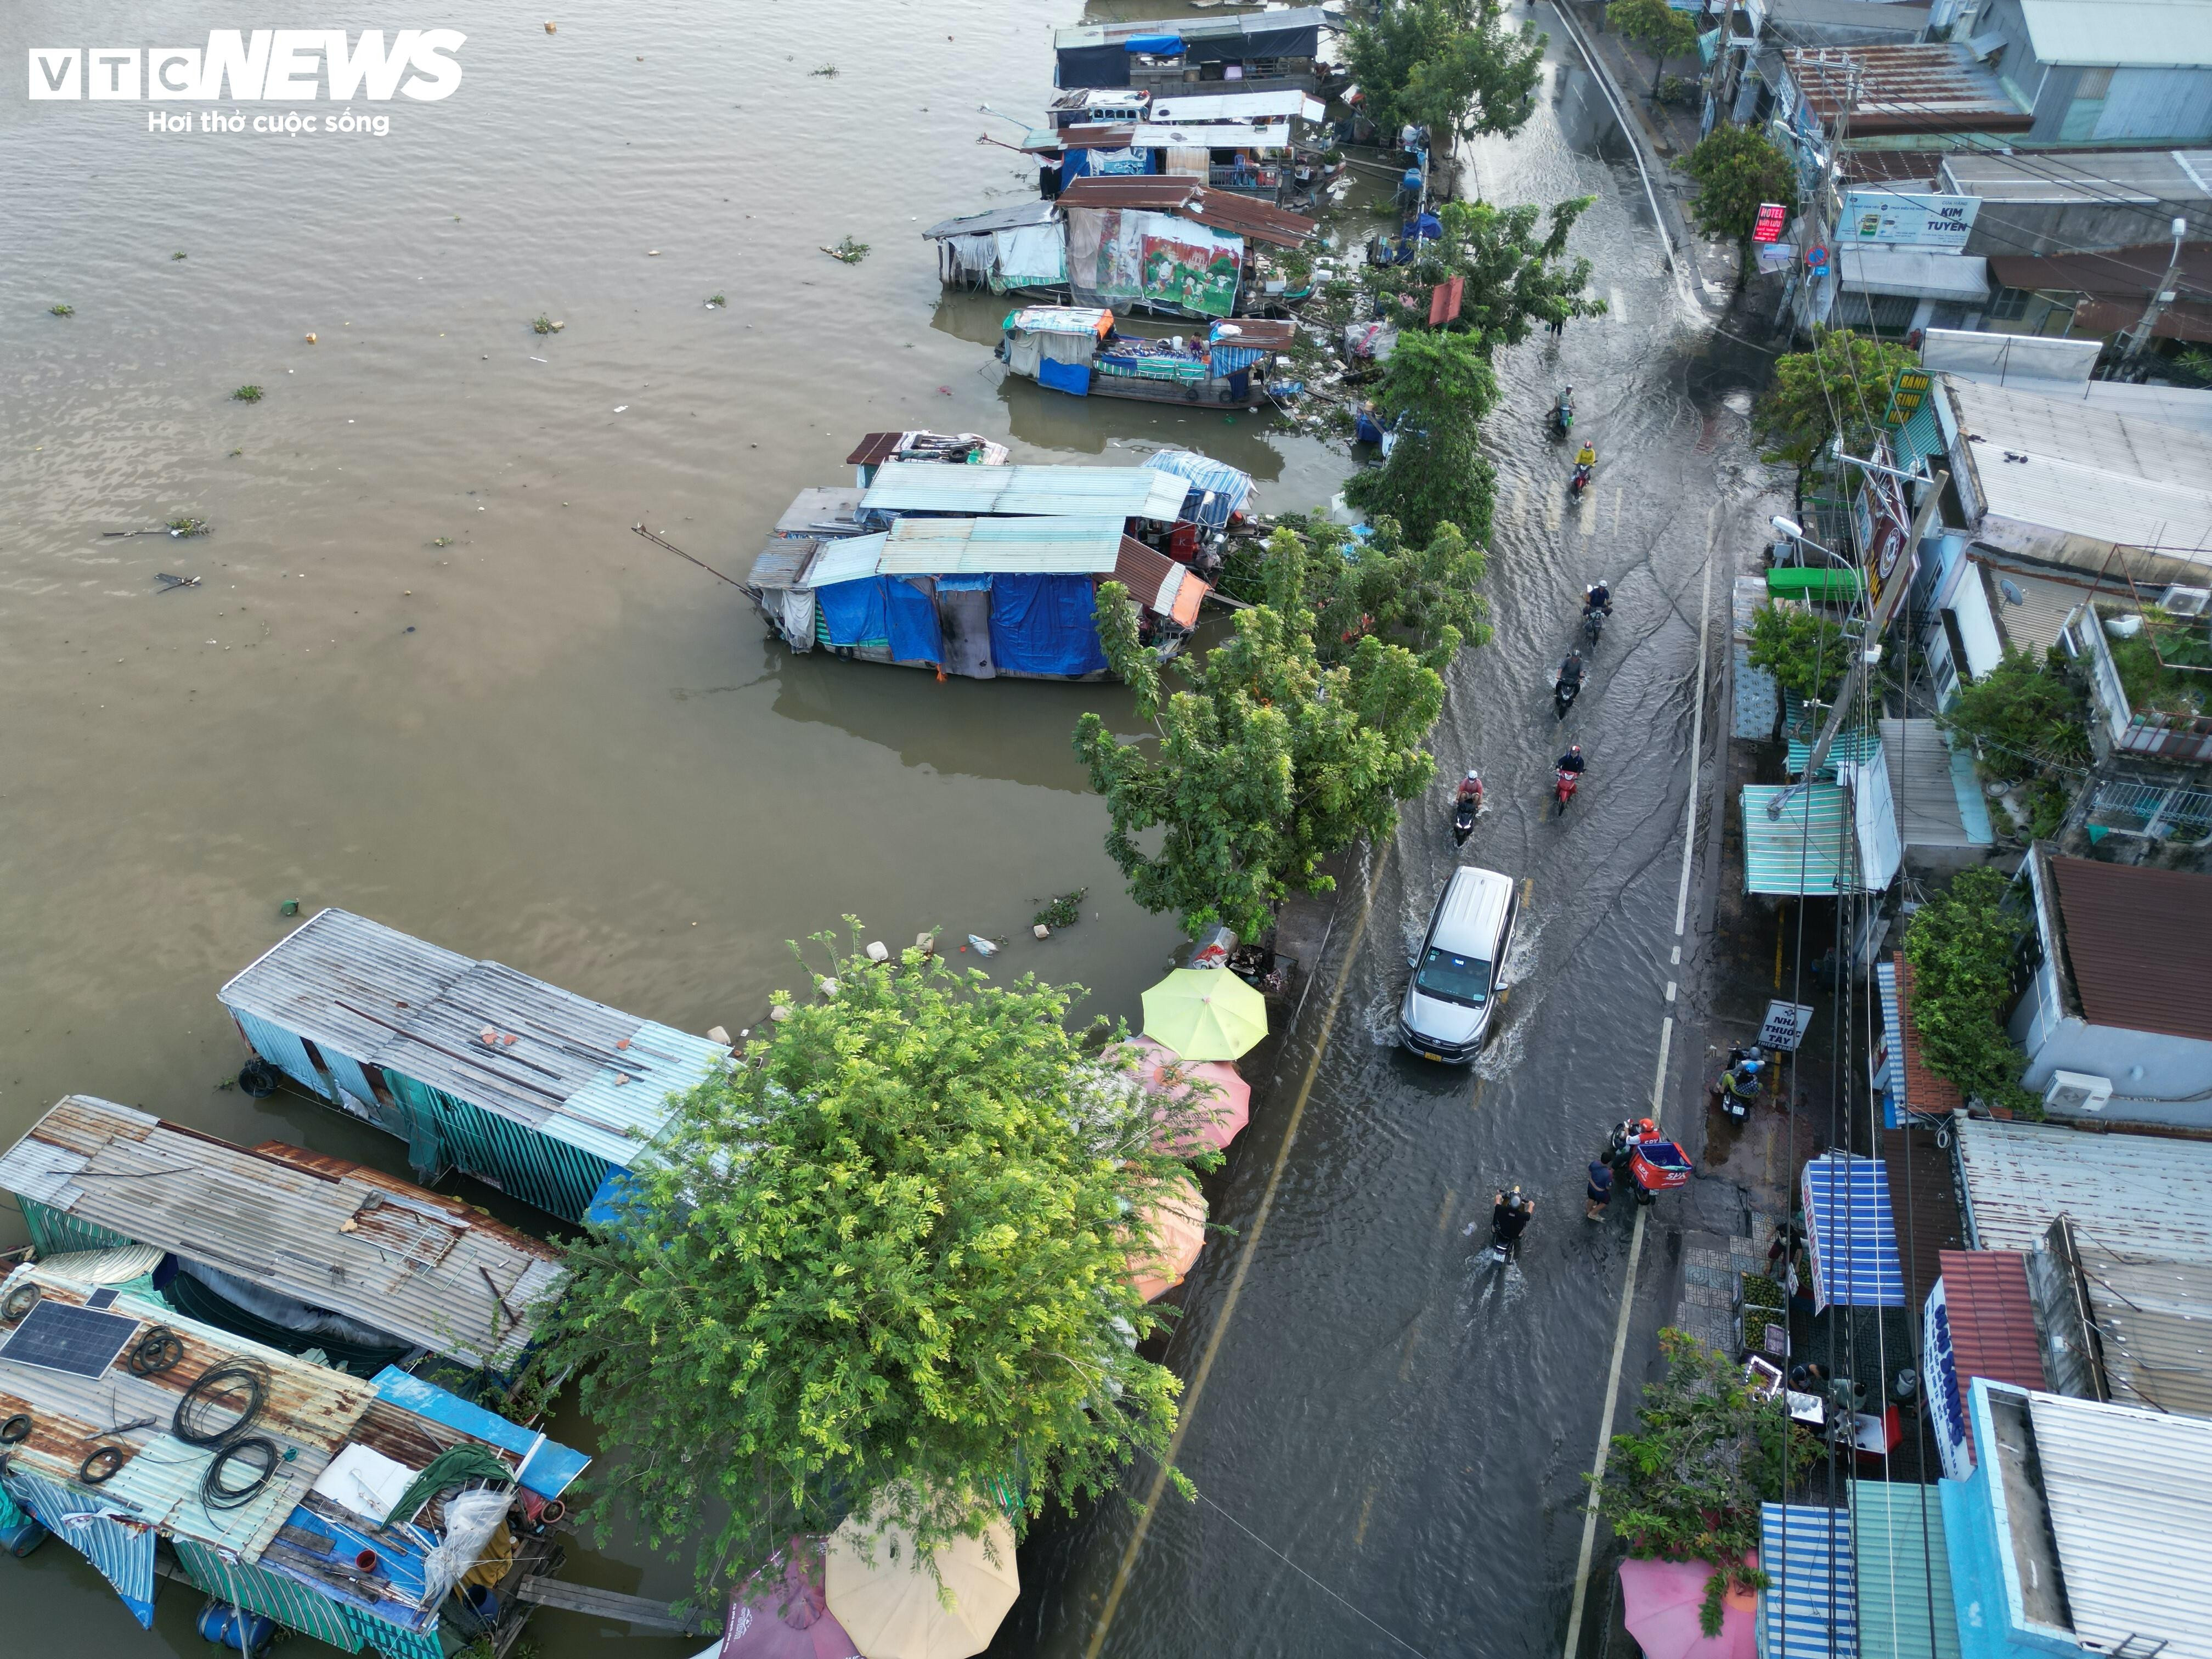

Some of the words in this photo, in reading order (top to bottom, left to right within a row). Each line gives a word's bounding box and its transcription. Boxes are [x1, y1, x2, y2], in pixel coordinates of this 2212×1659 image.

[1760, 208, 1783, 218] HOTEL
[1940, 207, 1963, 217] KIM
[1928, 218, 1967, 232] TUYẾN
[1896, 392, 1920, 407] SINH
